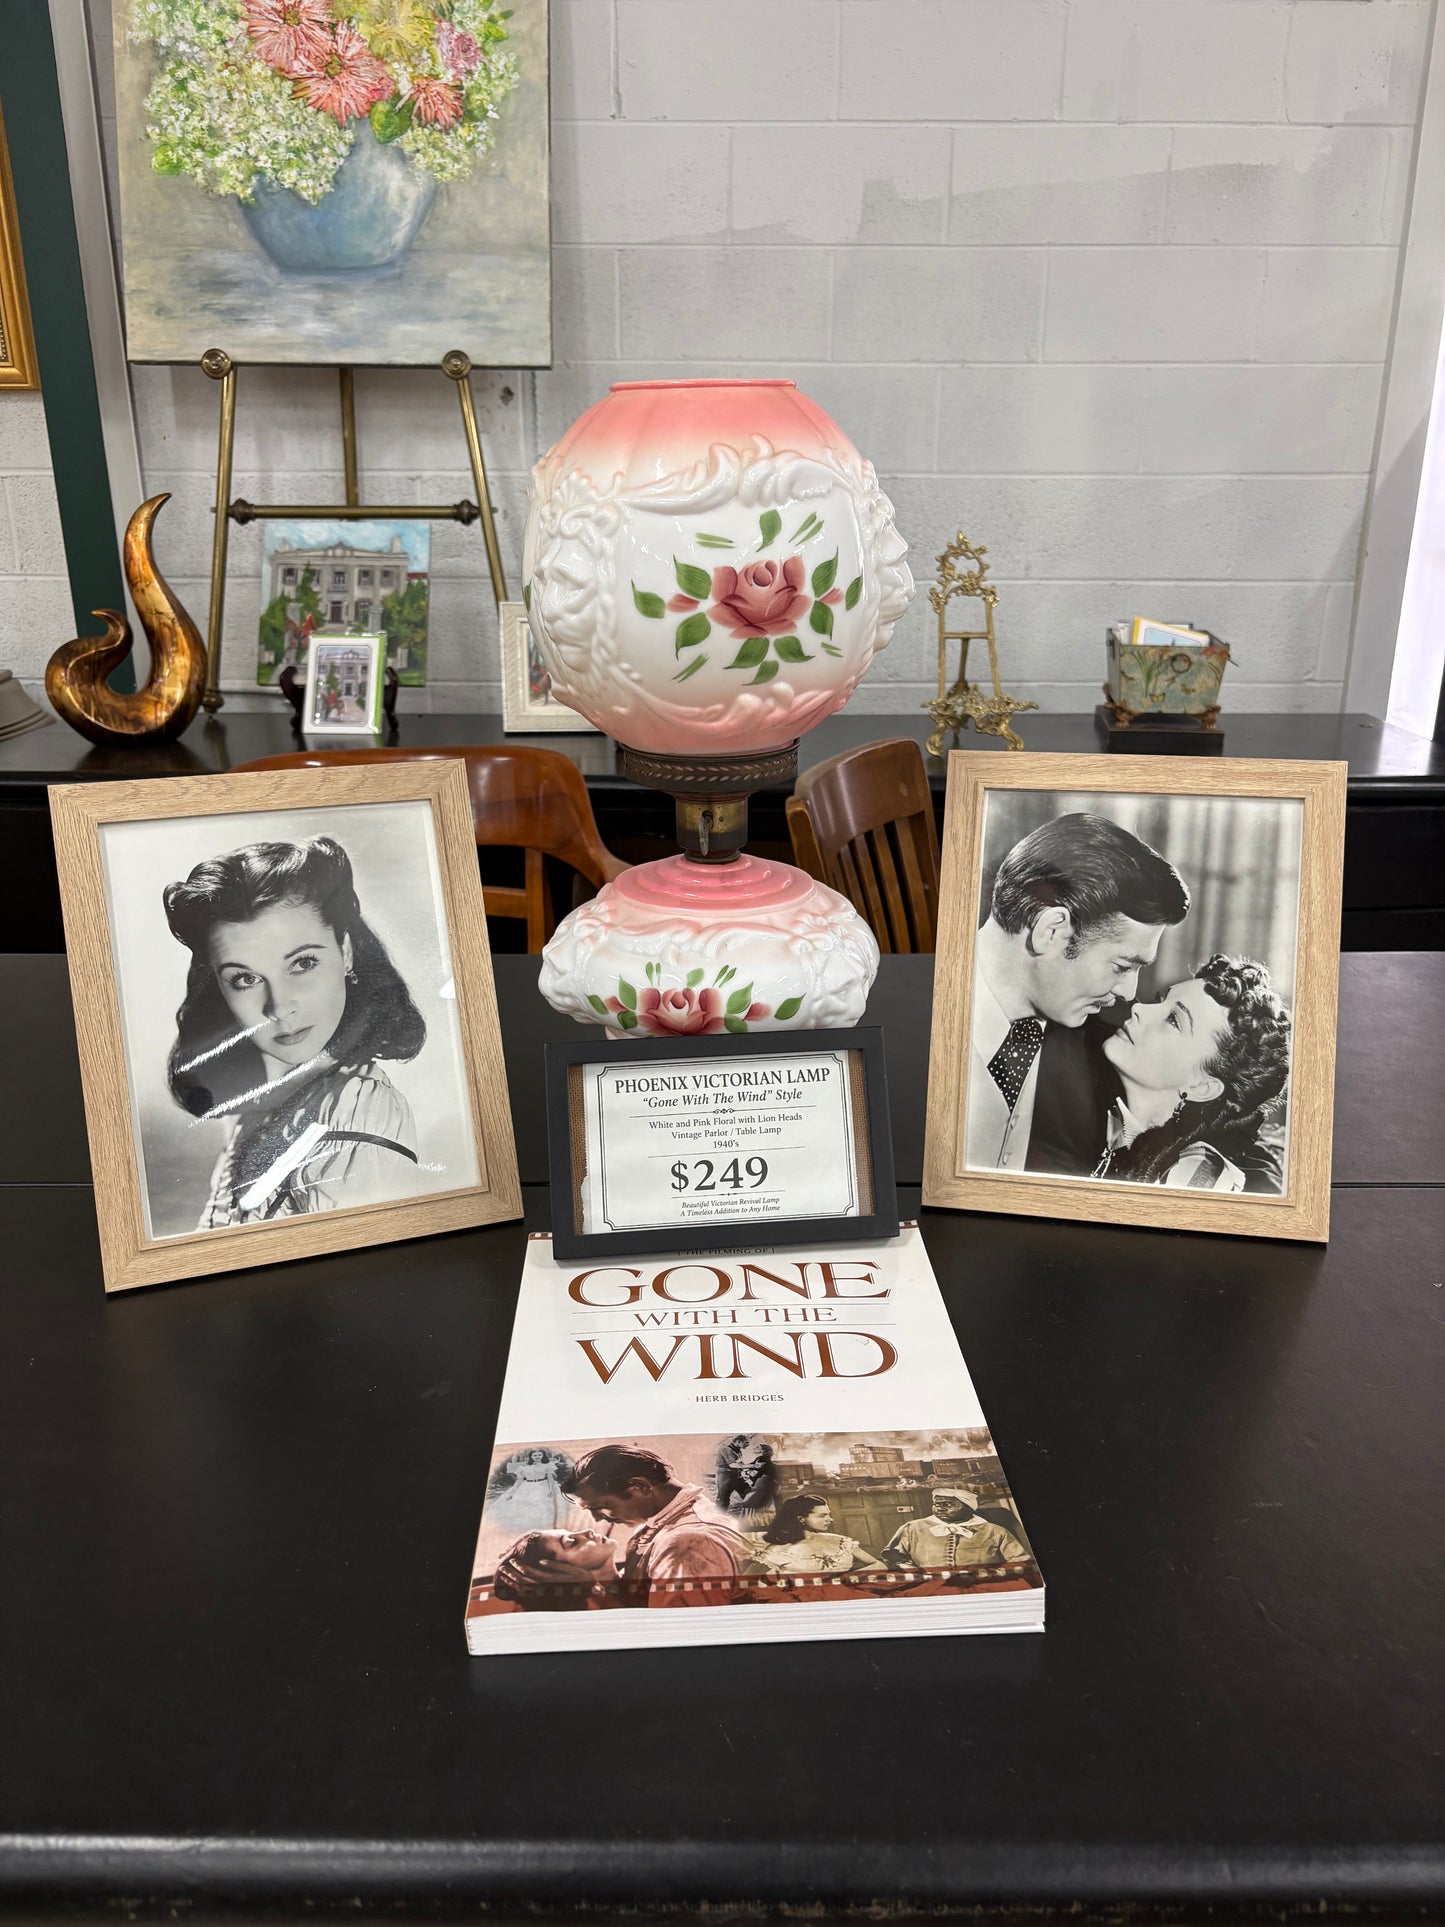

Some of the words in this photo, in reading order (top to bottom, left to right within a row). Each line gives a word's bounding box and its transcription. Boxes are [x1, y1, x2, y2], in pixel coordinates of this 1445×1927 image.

[615, 1076, 688, 1093] PHOENIX
[692, 1071, 782, 1089] VICTORIAN
[787, 1067, 830, 1083] LAMP
[682, 1094, 709, 1105] With
[712, 1092, 734, 1104] The
[776, 1088, 802, 1102] Style
[649, 1121, 673, 1129] White
[676, 1119, 691, 1128] and
[693, 1118, 711, 1126] Pink
[713, 1117, 736, 1126] Floral
[738, 1116, 756, 1124] with
[758, 1115, 776, 1123] Lion
[778, 1113, 803, 1122] Heads
[671, 1130, 702, 1140] Vintage
[704, 1129, 728, 1137] Parlor
[735, 1126, 757, 1135] Table
[759, 1126, 782, 1135] Lamp
[671, 1157, 768, 1193] $249
[682, 1201, 709, 1209] Beautiful
[687, 1208, 712, 1216] Timeless
[567, 1260, 892, 1307] GONE
[633, 1309, 738, 1328] WITH
[754, 1307, 837, 1322] THE
[575, 1331, 898, 1385] WIND
[695, 1395, 728, 1403] HERB
[732, 1394, 784, 1402] BRIDGES
